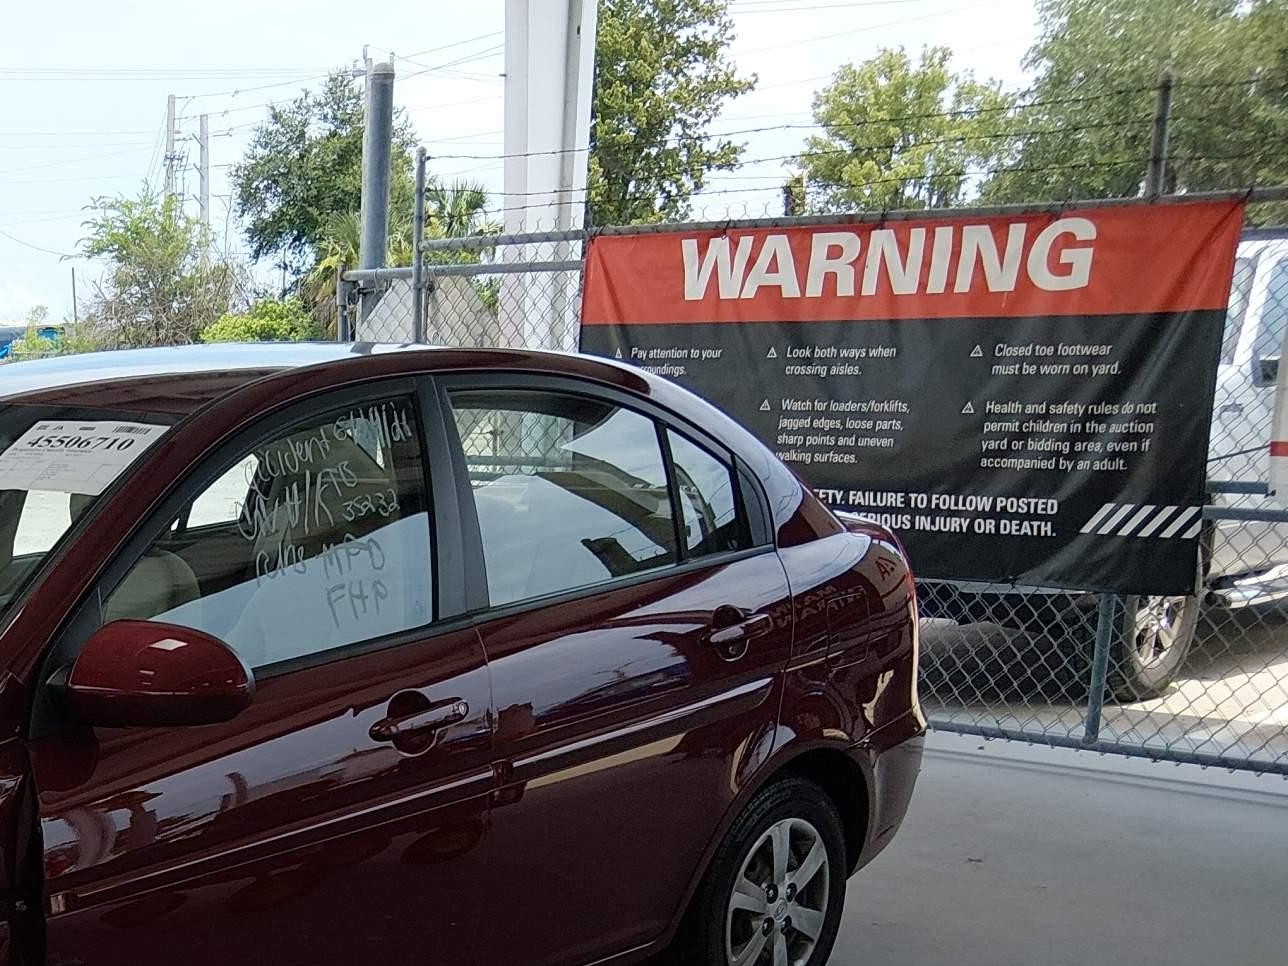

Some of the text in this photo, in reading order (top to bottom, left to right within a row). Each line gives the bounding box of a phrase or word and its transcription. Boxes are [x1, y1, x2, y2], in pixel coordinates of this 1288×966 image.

[681, 217, 1097, 300] WARNING
[631, 346, 723, 361] Pay attention to your
[786, 344, 897, 360] Look both ways when
[994, 342, 1113, 357] Closed toe footwear
[785, 362, 862, 378] crossing aisles.
[991, 360, 1122, 378] must be worn on yard.
[781, 398, 911, 415] Watch for loaders/forklifts,
[985, 400, 1158, 417] Health and safety rules do not
[777, 415, 905, 433] jagged edges, loose parts,
[983, 419, 1155, 434] permit children in the auction
[26, 434, 136, 452] 45506710
[776, 433, 895, 448] sharp points and uneven
[981, 437, 1152, 455] yard or bidding area, even if
[776, 450, 859, 465] walking surfaces.
[980, 457, 1129, 473] accompanied by an adult.
[813, 488, 1059, 515] ETY. FAILURE TO FOLLOW POSTED
[914, 515, 971, 533] INJURY
[973, 518, 996, 534] OR
[999, 519, 1057, 537] DEATH.
